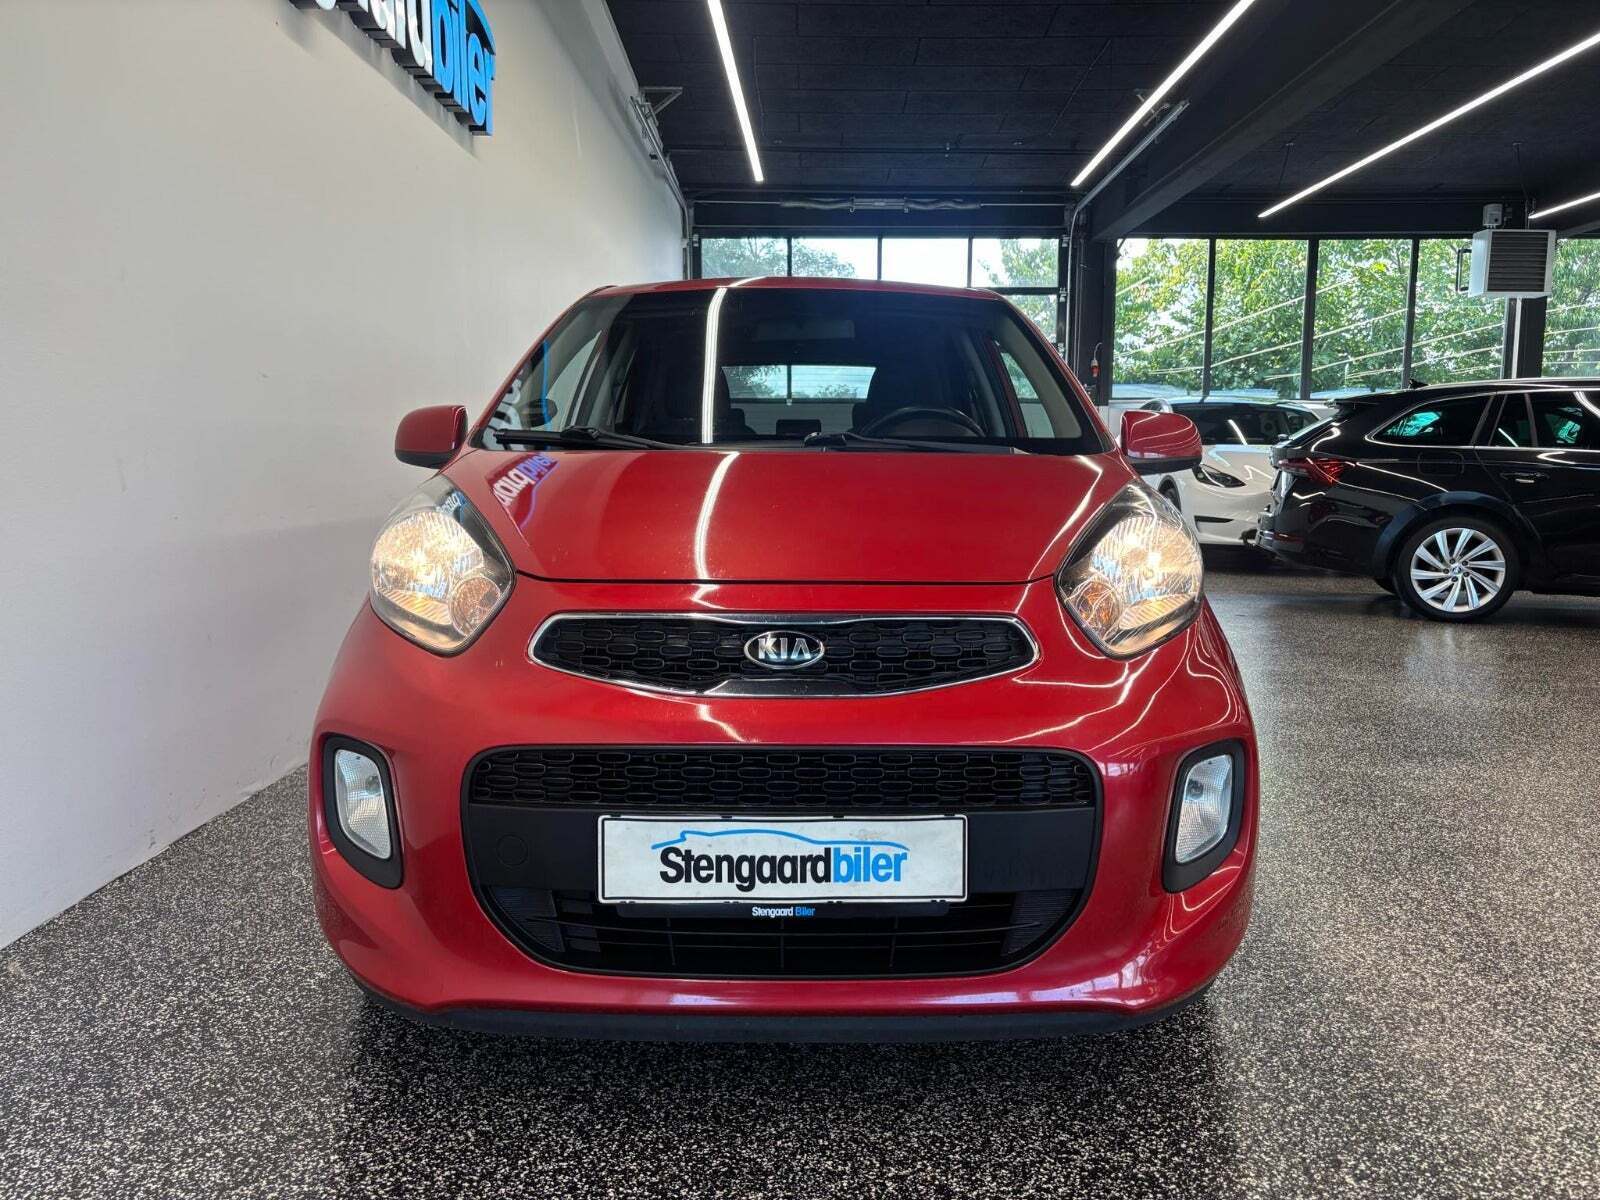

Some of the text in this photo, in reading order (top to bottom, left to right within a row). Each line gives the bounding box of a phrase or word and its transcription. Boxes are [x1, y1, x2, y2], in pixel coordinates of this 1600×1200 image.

[757, 637, 812, 660] KIA
[659, 846, 908, 892] Stengaardbiler
[751, 906, 816, 918] Stengaard Biler
